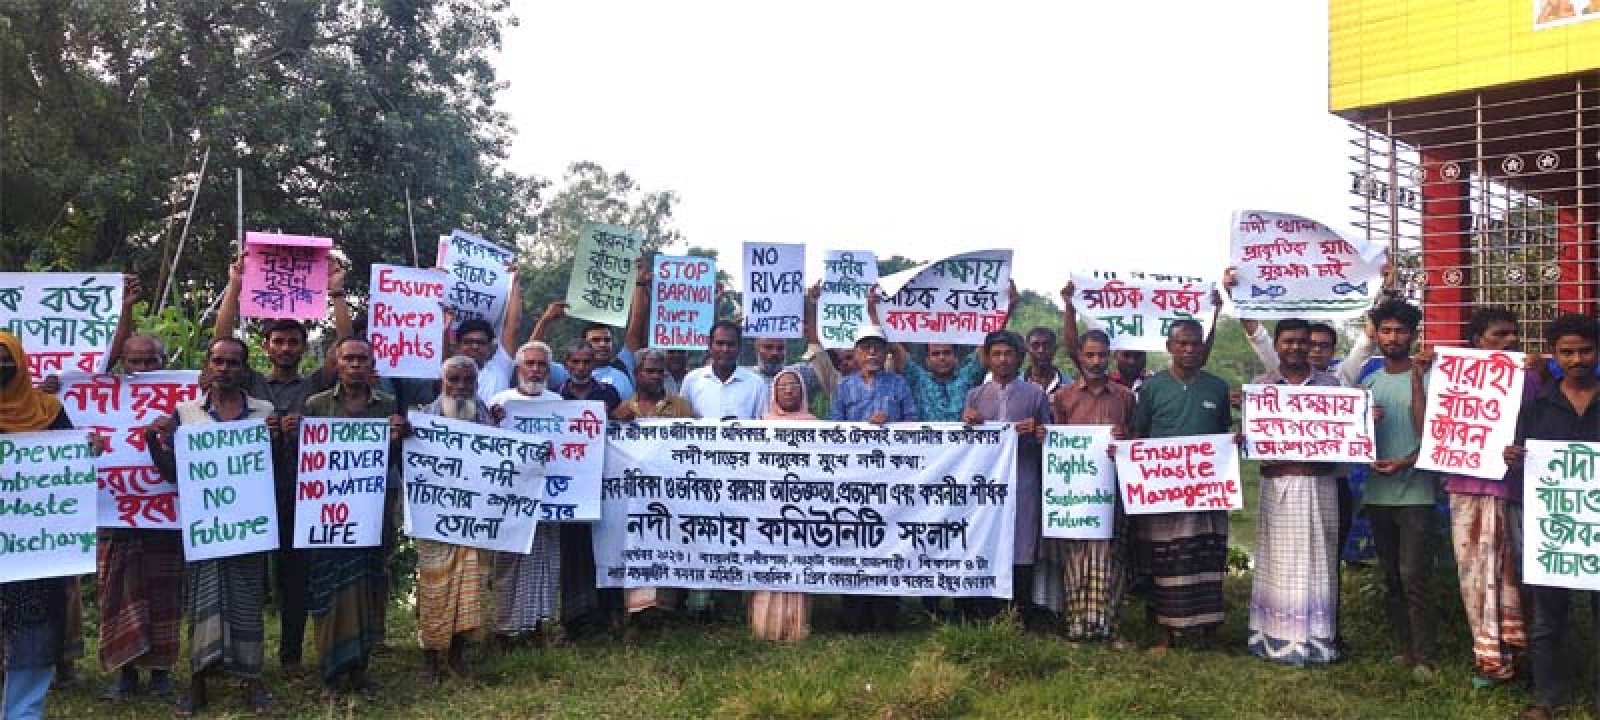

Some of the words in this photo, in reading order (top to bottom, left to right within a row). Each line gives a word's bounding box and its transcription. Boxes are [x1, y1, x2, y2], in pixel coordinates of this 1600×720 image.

[752, 247, 779, 266] NO
[659, 261, 709, 281] STOP
[750, 270, 802, 294] RIVER
[378, 270, 445, 298] Ensure
[374, 301, 435, 328] River
[657, 305, 698, 322] River
[752, 297, 772, 314] NO
[745, 315, 800, 332] WATER
[371, 331, 435, 368] Rights
[63, 375, 121, 414] নদী
[187, 431, 215, 451] NO
[217, 425, 270, 448] RIVER
[303, 424, 328, 445] NO
[330, 421, 390, 443] FOREST
[1050, 431, 1092, 449] River
[301, 452, 326, 472] NO
[328, 450, 384, 471] RIVER
[1130, 441, 1215, 462] Ensure
[1548, 444, 1600, 481] নদী
[0, 464, 96, 492] ntreated
[189, 461, 218, 481] NO
[227, 452, 265, 475] LIFE
[1047, 453, 1099, 484] Rights
[1140, 461, 1215, 479] Waste
[203, 486, 236, 510] NO
[300, 479, 325, 500] NO
[327, 475, 384, 496] WATER
[321, 502, 349, 523] NO
[1048, 511, 1100, 529] Futures
[309, 522, 358, 545] LIFE
[627, 502, 673, 541] নদী
[678, 511, 751, 546] রক্ষায়
[757, 505, 888, 549] কমিউনিটি
[896, 517, 969, 553] সংলাপ
